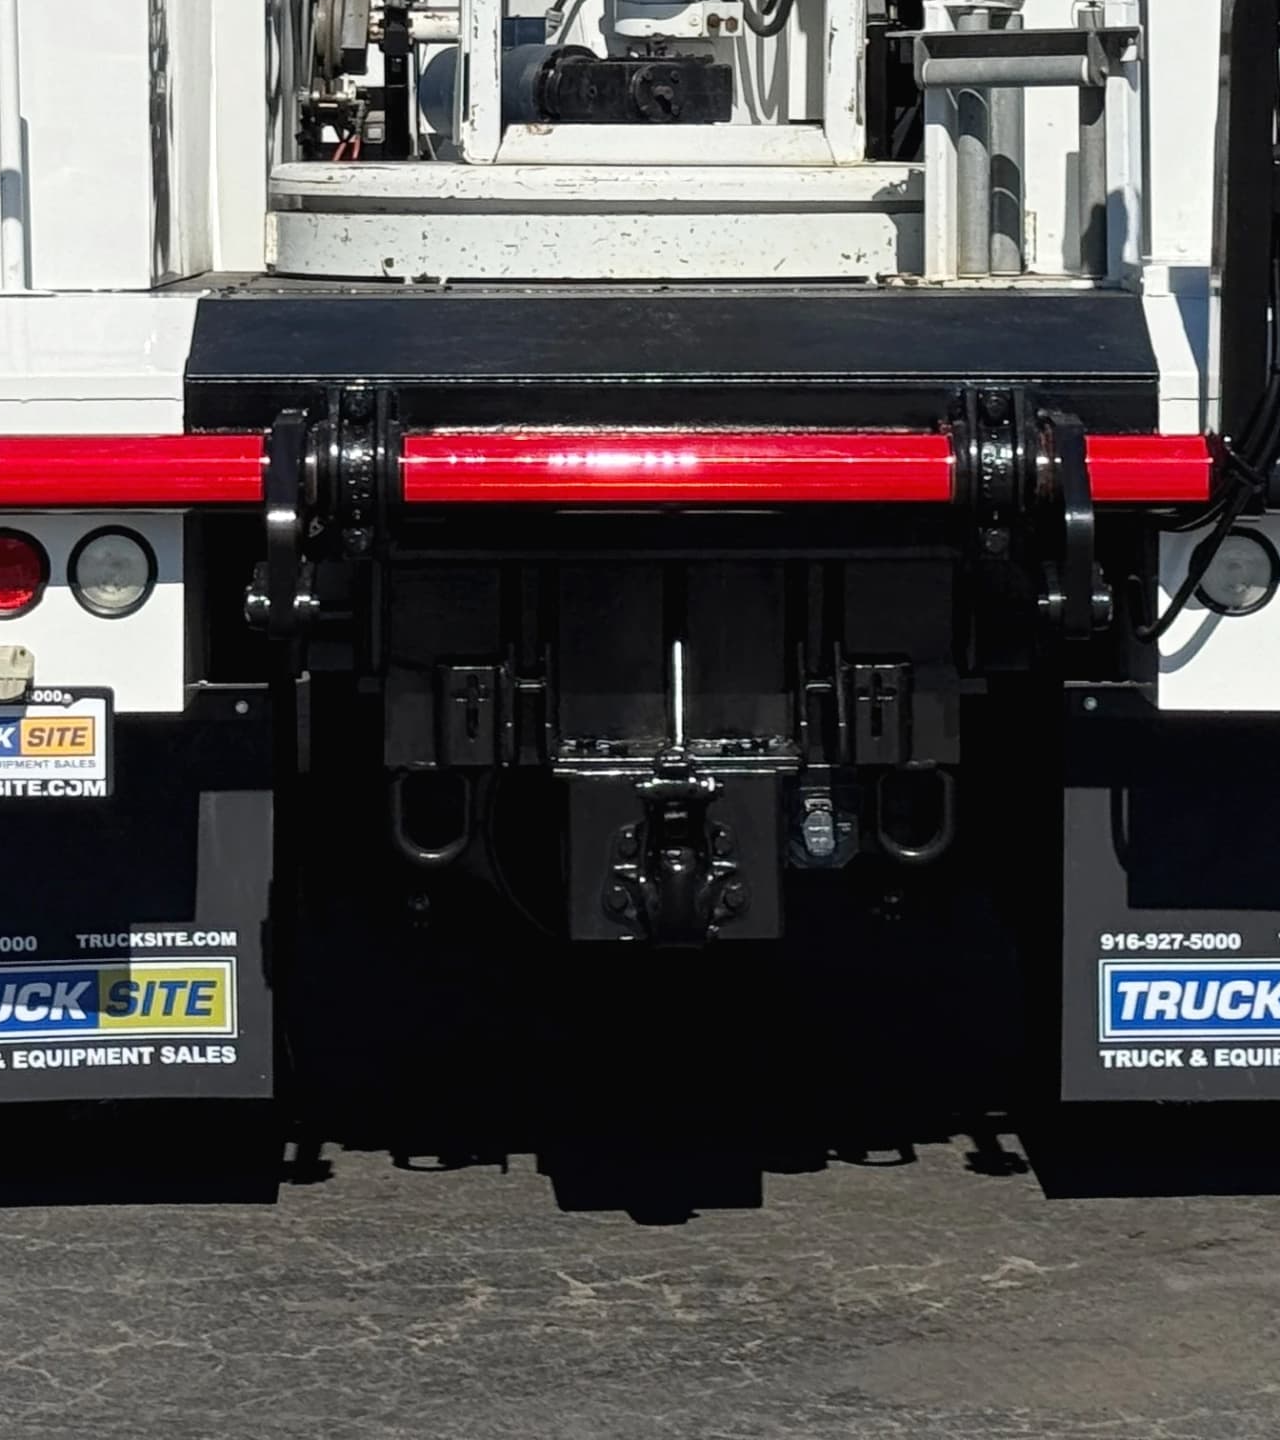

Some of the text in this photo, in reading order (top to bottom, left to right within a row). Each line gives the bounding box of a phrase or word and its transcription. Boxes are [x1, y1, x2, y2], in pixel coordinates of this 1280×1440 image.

[27, 726, 88, 748] SITE
[54, 759, 96, 769] SALES
[76, 931, 237, 949] TRUCKSITE.COM
[1100, 933, 1242, 950] 916-927-5000
[105, 980, 217, 1019] SITE
[13, 1047, 154, 1069] EQUIPMENT
[160, 1046, 237, 1064] SALES
[1100, 1049, 1184, 1068] TRUCK
[1189, 1049, 1208, 1068] &
